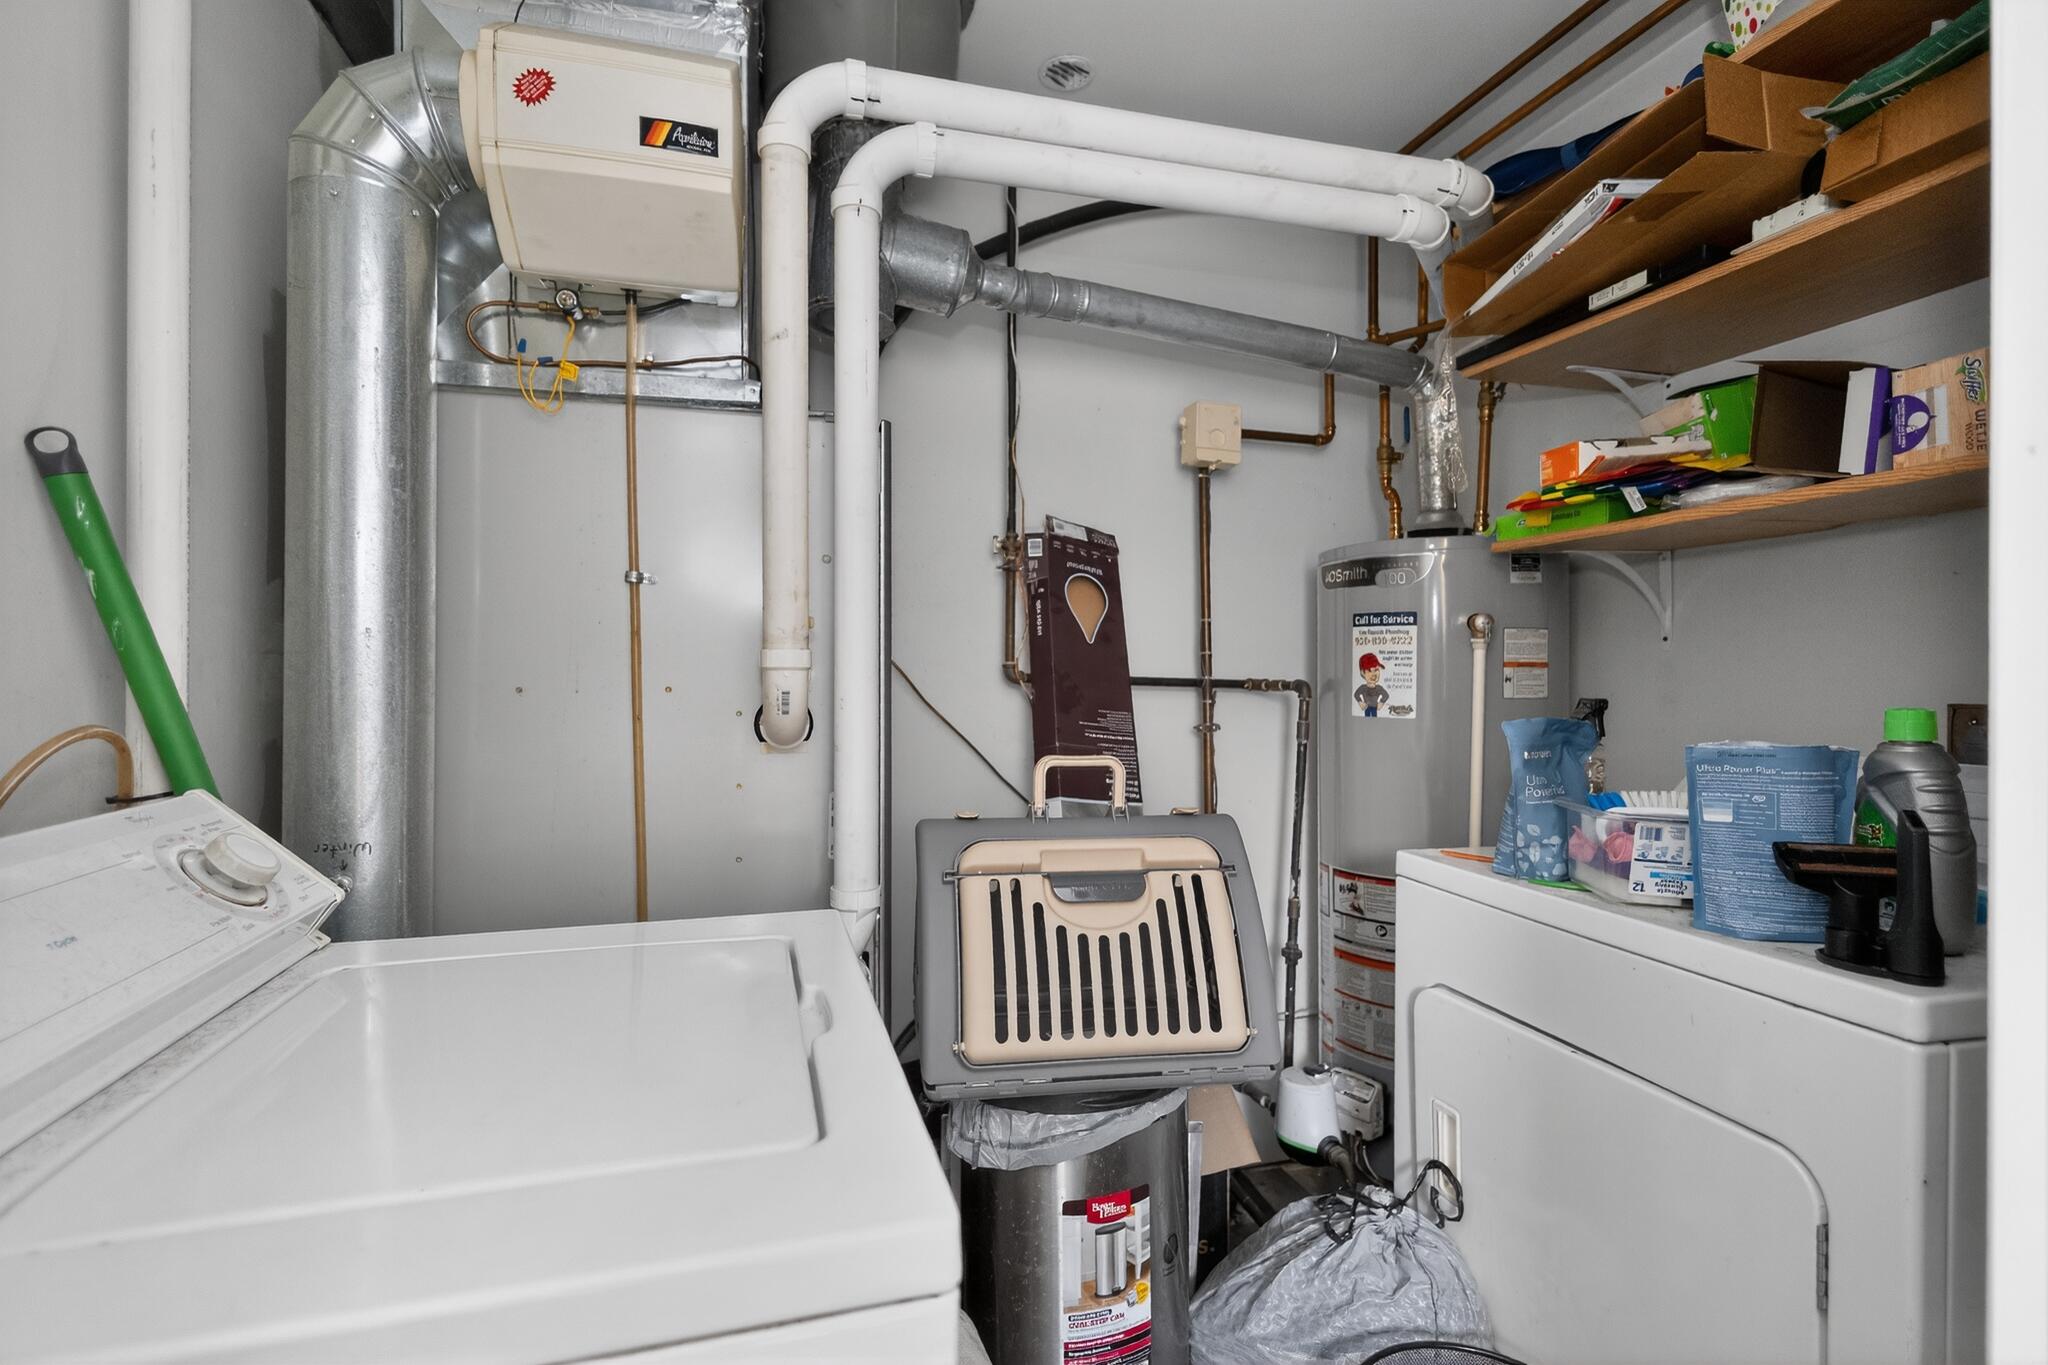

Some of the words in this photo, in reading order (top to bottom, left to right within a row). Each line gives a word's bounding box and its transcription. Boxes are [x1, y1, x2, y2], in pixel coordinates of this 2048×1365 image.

[1355, 615, 1369, 625] Call
[1370, 614, 1381, 624] for
[1382, 613, 1414, 624] Service
[314, 842, 372, 859] Winter
